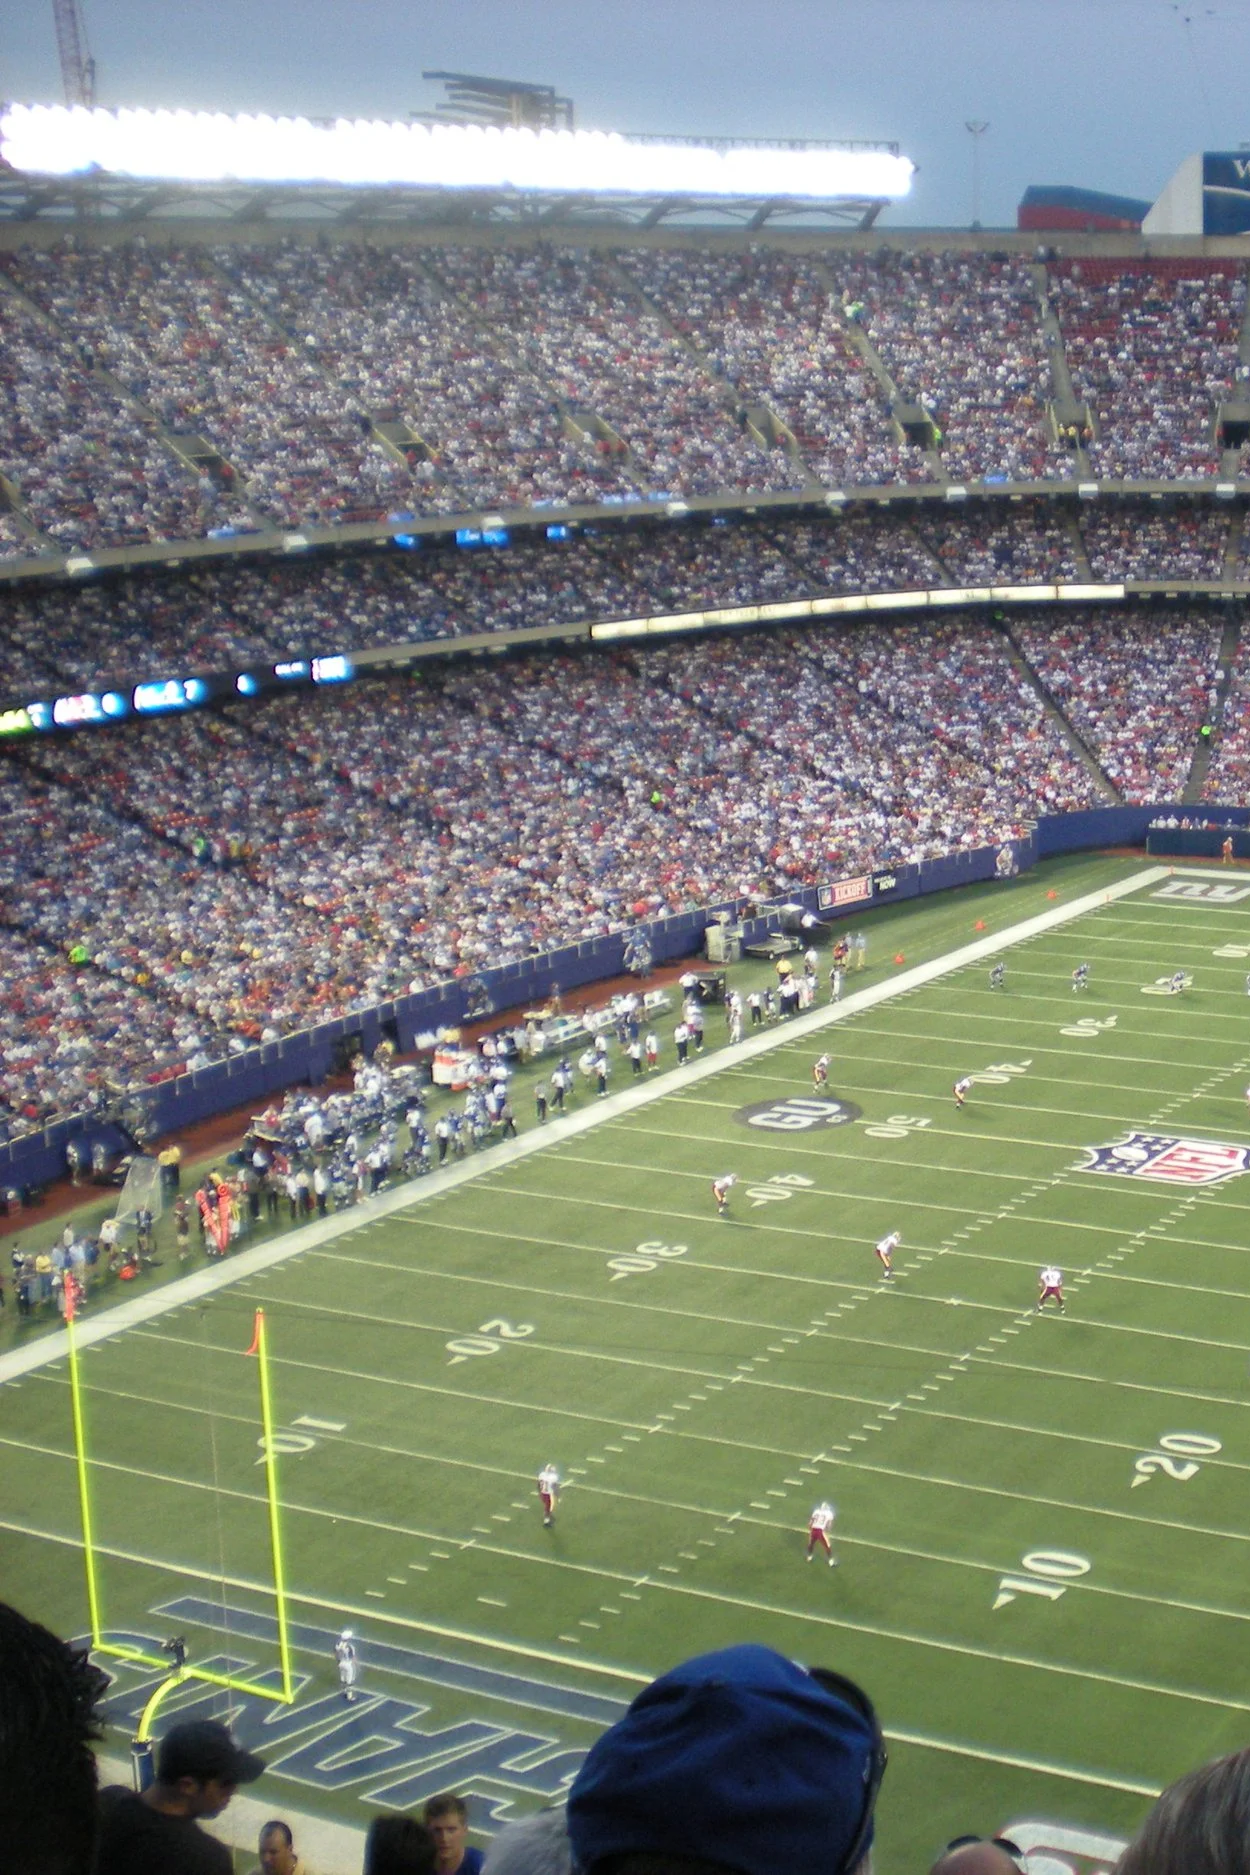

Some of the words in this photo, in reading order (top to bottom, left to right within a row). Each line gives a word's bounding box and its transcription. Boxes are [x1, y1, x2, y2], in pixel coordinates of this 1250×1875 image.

[1059, 1017, 1118, 1037] 30
[969, 1063, 1027, 1084] 40
[864, 1114, 933, 1138] 50
[1140, 1146, 1242, 1181] NFL
[745, 1173, 816, 1201] 40
[606, 1240, 688, 1272] 30
[445, 1318, 535, 1357] 20
[256, 1414, 348, 1454] 10
[1134, 1433, 1222, 1481] 20
[999, 1551, 1092, 1602] 10
